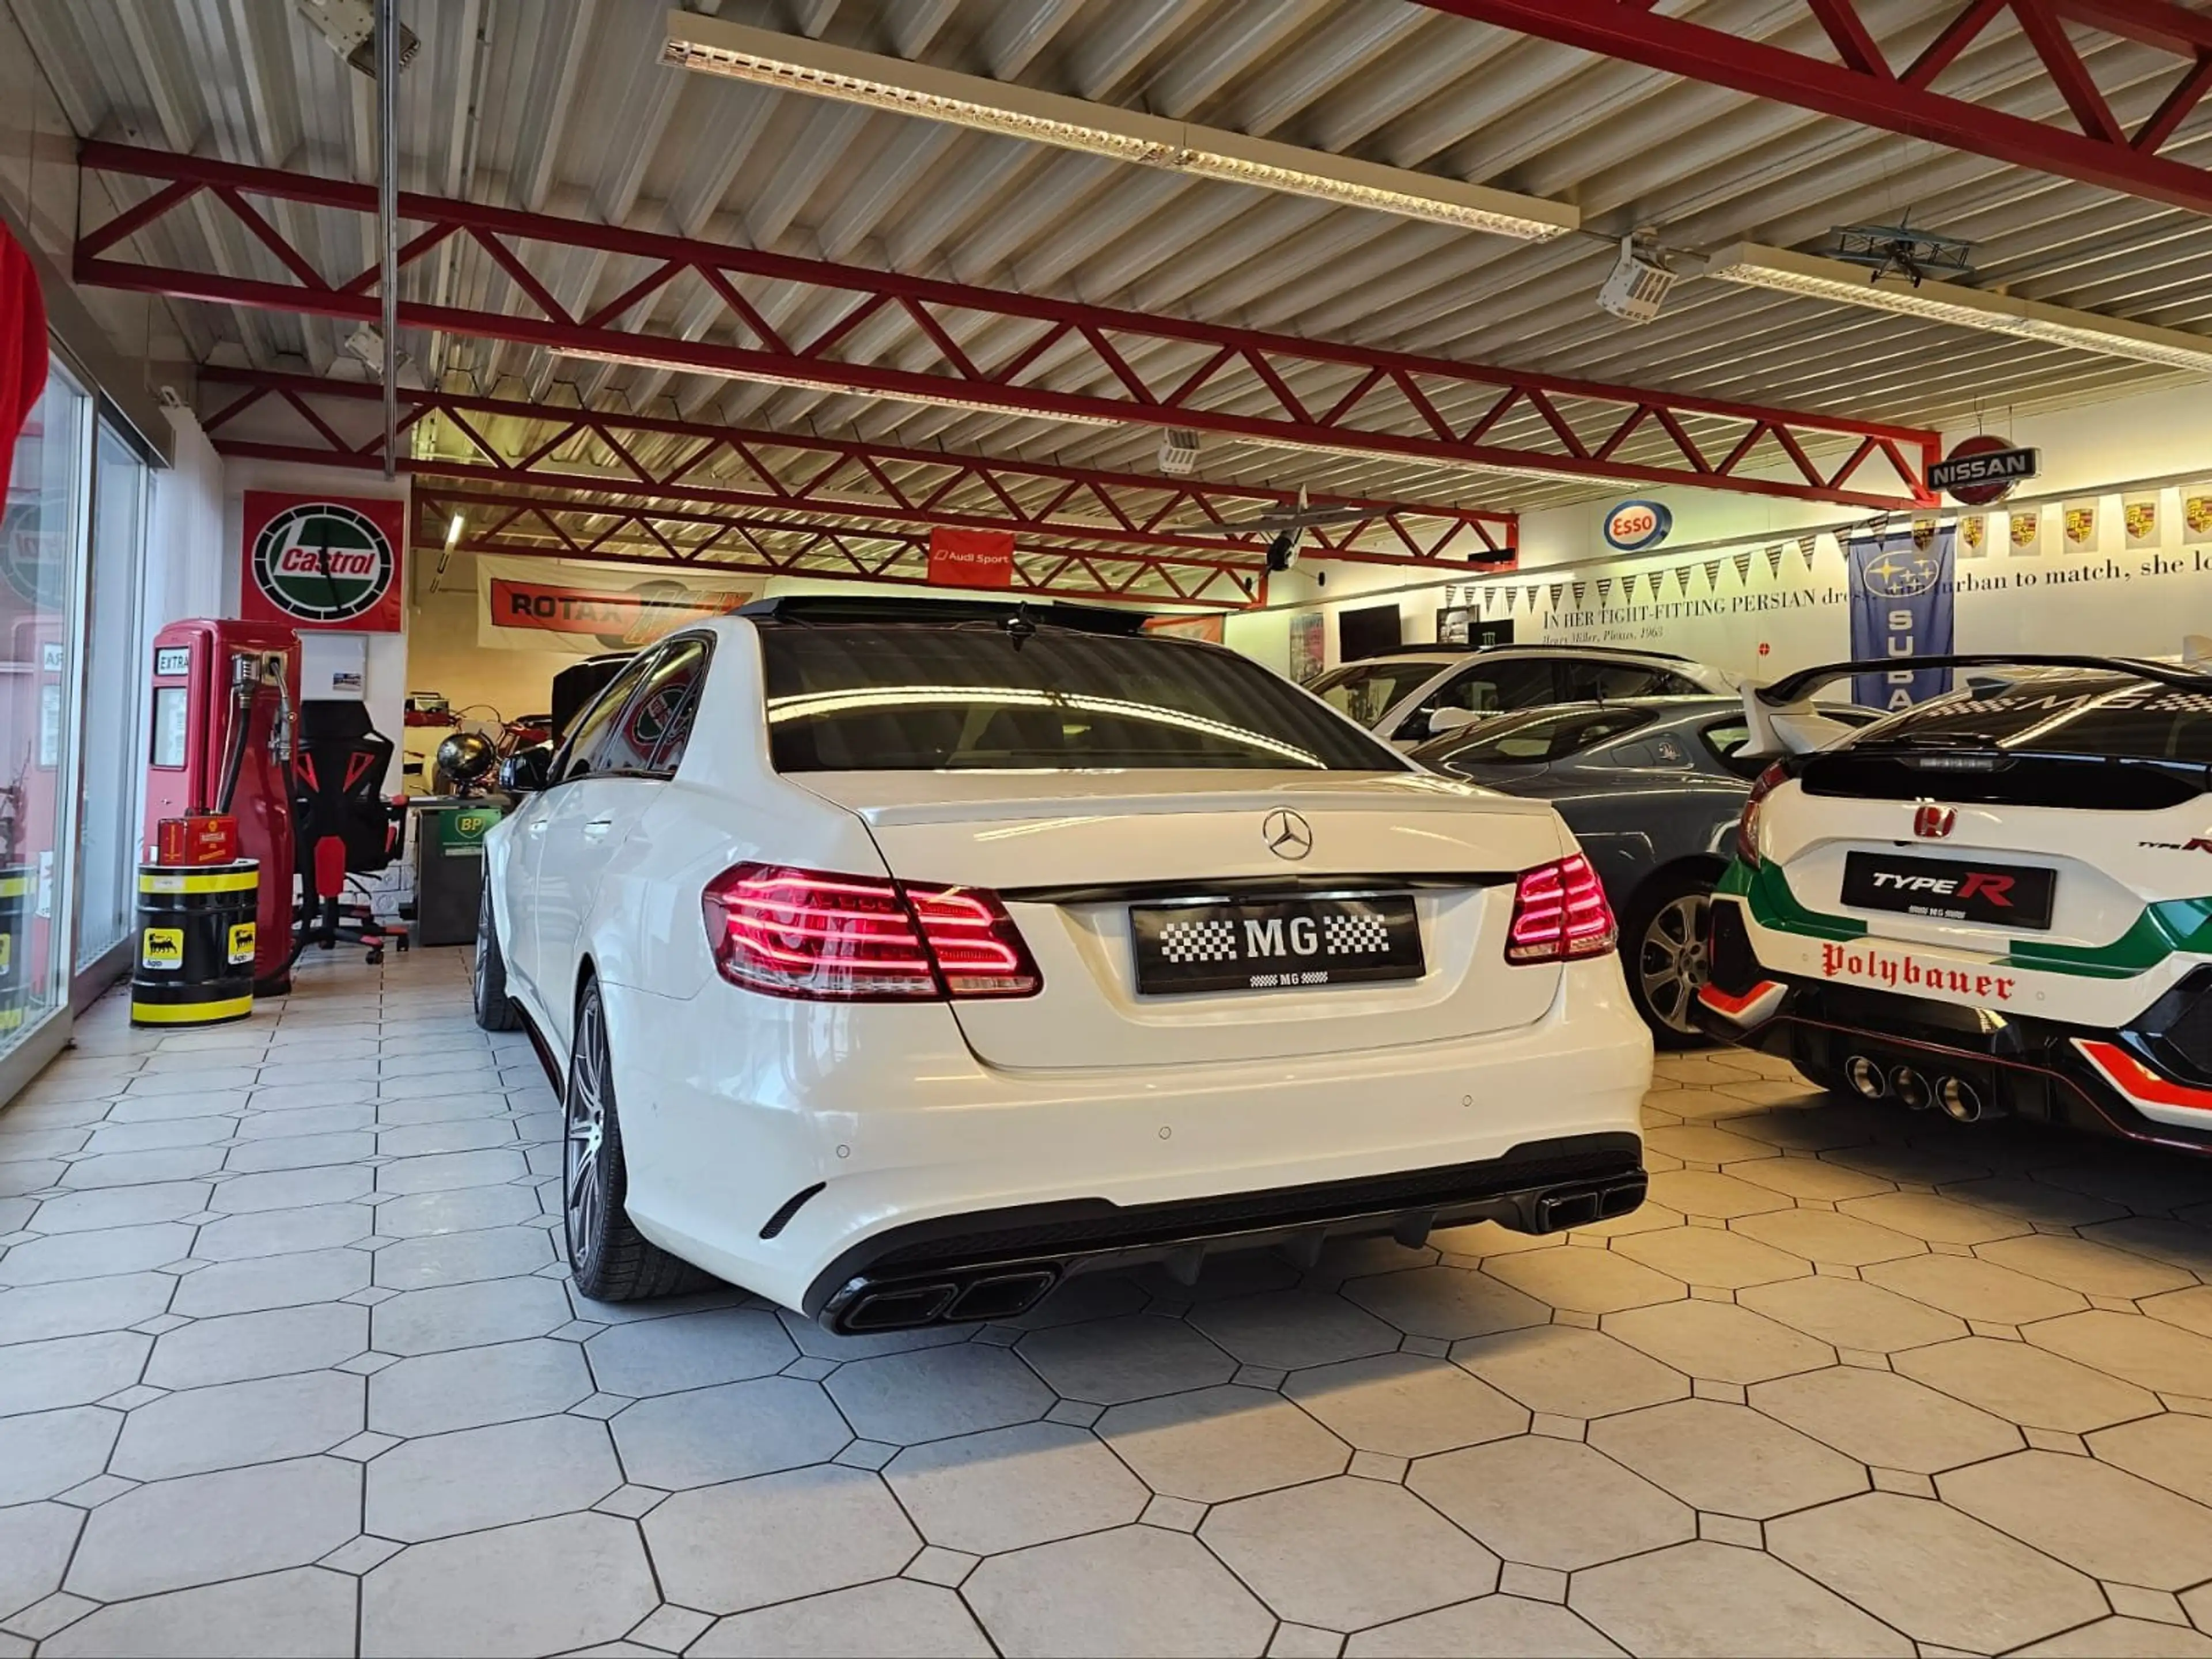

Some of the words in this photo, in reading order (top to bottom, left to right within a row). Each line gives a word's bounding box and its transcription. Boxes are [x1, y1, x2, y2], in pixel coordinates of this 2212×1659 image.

[1933, 454, 2026, 485] NISSAN
[949, 552, 975, 562] Audi
[976, 554, 1009, 565] Sport
[1564, 611, 1594, 628] HER
[1599, 597, 1726, 625] TIGHT-FITTING
[1732, 588, 1816, 613] PERSIAN
[2016, 572, 2036, 587] to
[2046, 559, 2131, 585] match,
[2141, 554, 2184, 576] she
[511, 593, 622, 622] ROTAX
[461, 817, 482, 831] BP
[1873, 872, 1959, 895] TYPE
[1956, 872, 2016, 907] R
[1243, 916, 1319, 958] MG
[1280, 973, 1300, 986] MG
[1821, 943, 2016, 1001] Polybauer
